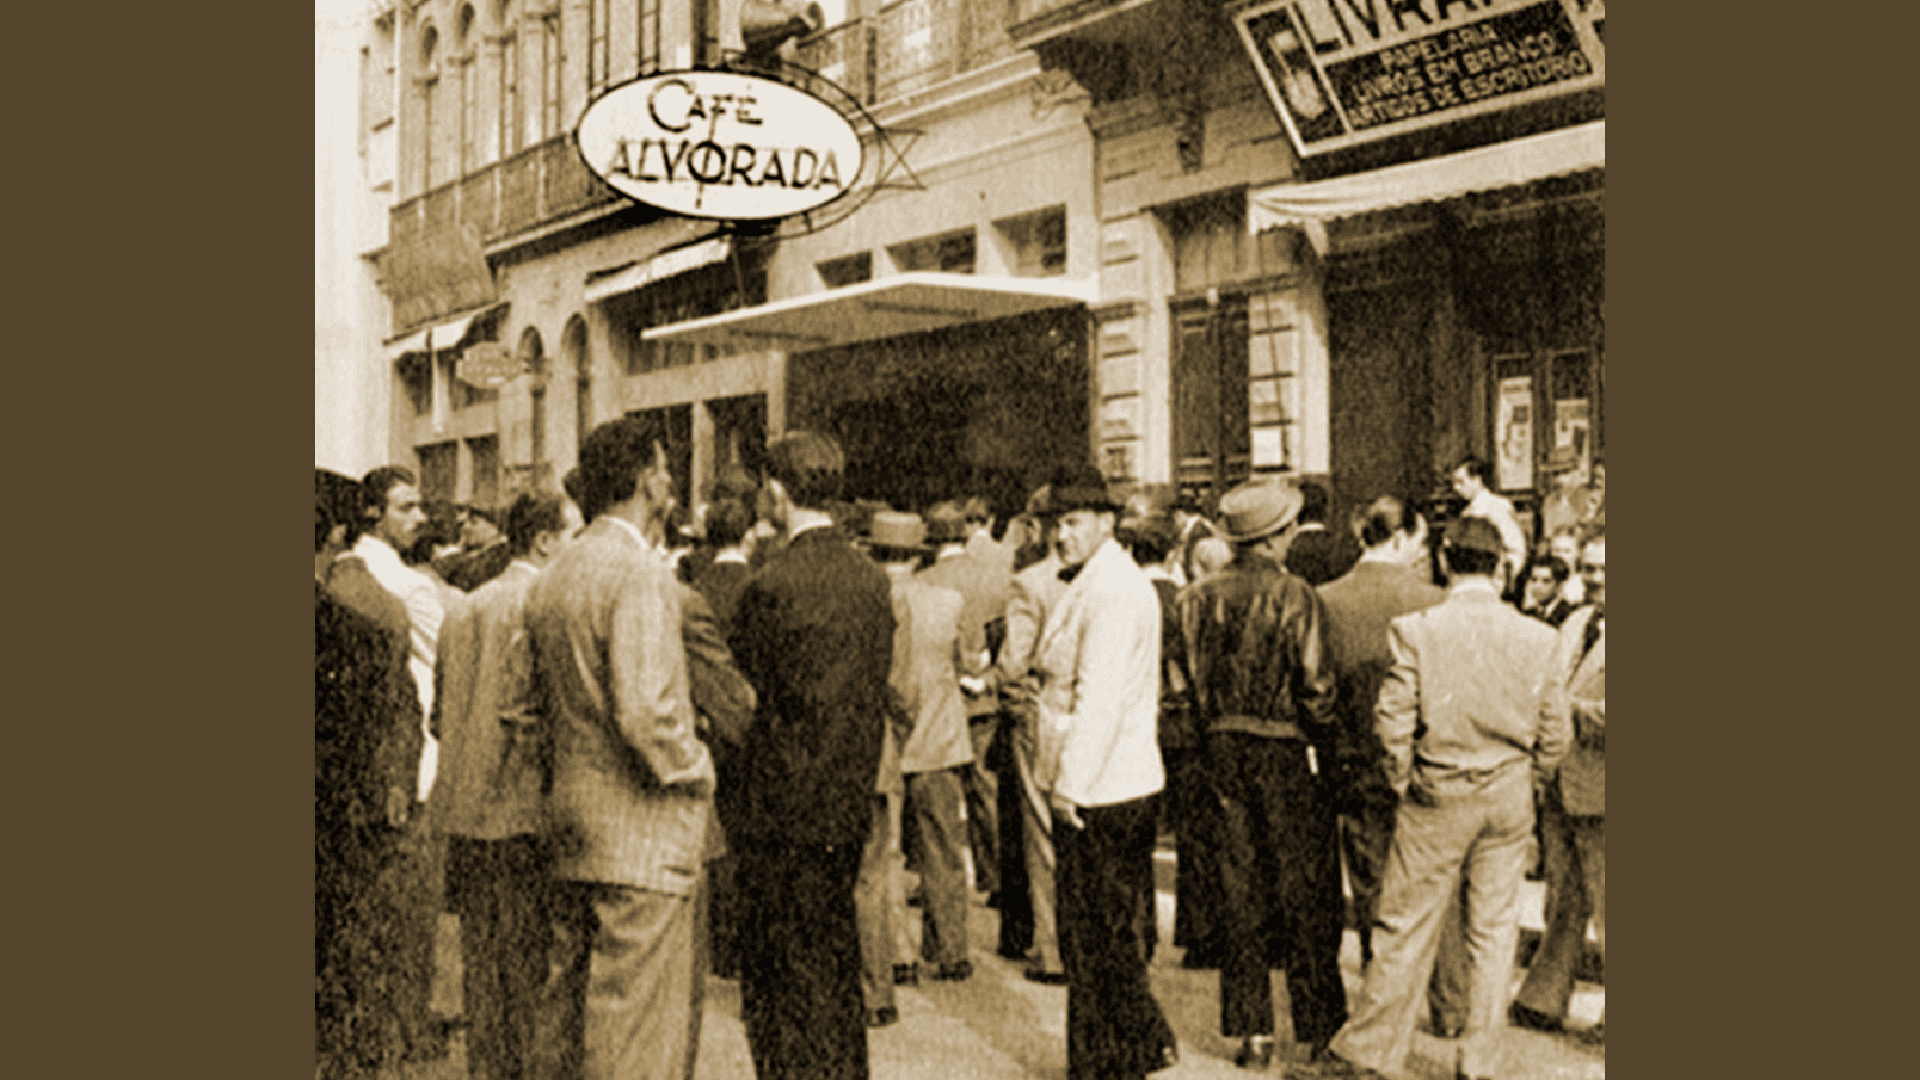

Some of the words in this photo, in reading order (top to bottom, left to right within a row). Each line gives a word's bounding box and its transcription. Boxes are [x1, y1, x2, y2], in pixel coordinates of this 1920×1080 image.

[1423, 57, 1463, 85] EM
[1461, 30, 1558, 75] BRANCO
[1430, 82, 1461, 107] DE
[606, 138, 841, 191] ALVORADA
